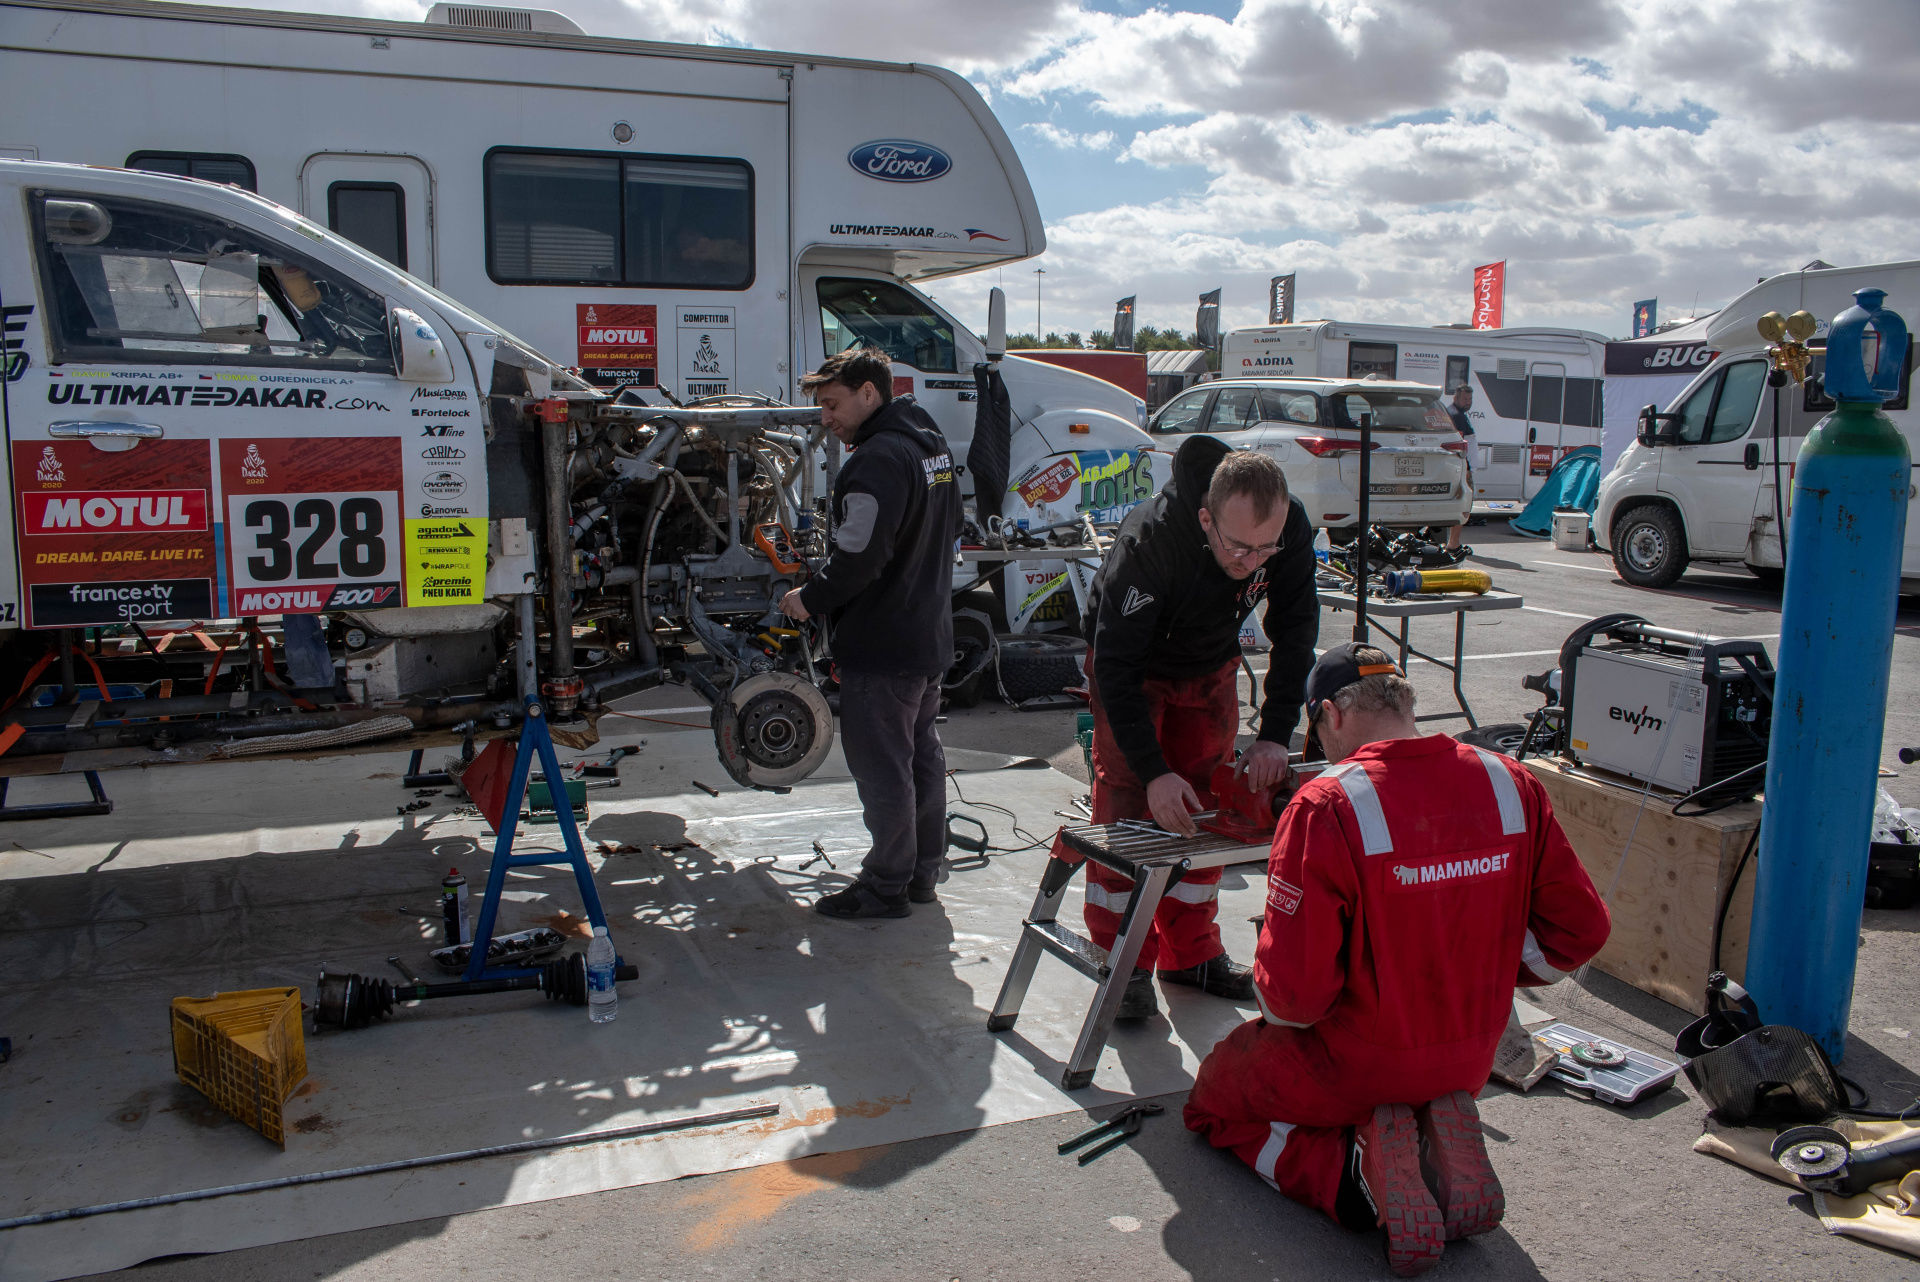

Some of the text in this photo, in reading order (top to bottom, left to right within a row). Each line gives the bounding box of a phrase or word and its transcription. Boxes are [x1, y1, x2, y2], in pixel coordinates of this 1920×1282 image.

[868, 145, 933, 176] Ford
[683, 314, 729, 324] COMPETITOR
[587, 329, 648, 344] MOTUL
[693, 360, 721, 374] DAKAR
[1254, 356, 1294, 366] ADRIA
[71, 371, 184, 380] DAVID KRIPAL AB+
[616, 377, 640, 386] sport
[688, 383, 728, 395] ULTIMATE
[420, 409, 471, 417] Fortelock
[420, 425, 465, 437] XTline
[428, 445, 460, 459] PRIM
[36, 469, 67, 482] DAKAR
[241, 466, 269, 478] DAKAR
[1080, 452, 1130, 485] energy
[1075, 450, 1155, 513] SHOT
[1025, 484, 1048, 504] 2020
[1420, 485, 1448, 493] RACING
[41, 496, 190, 528] MOTUL
[418, 526, 459, 534] agados
[245, 497, 386, 582] 328
[35, 549, 205, 565] DREAM. DARE. LIVE IT.
[432, 576, 472, 587] premio
[1024, 571, 1067, 585] HICA
[330, 586, 396, 605] 300V
[422, 588, 472, 597] PNEU KAFKA
[240, 591, 323, 611] MOTUL
[118, 601, 173, 622] sport
[1608, 706, 1663, 734] ewm
[1420, 853, 1510, 883] MAMMOET
